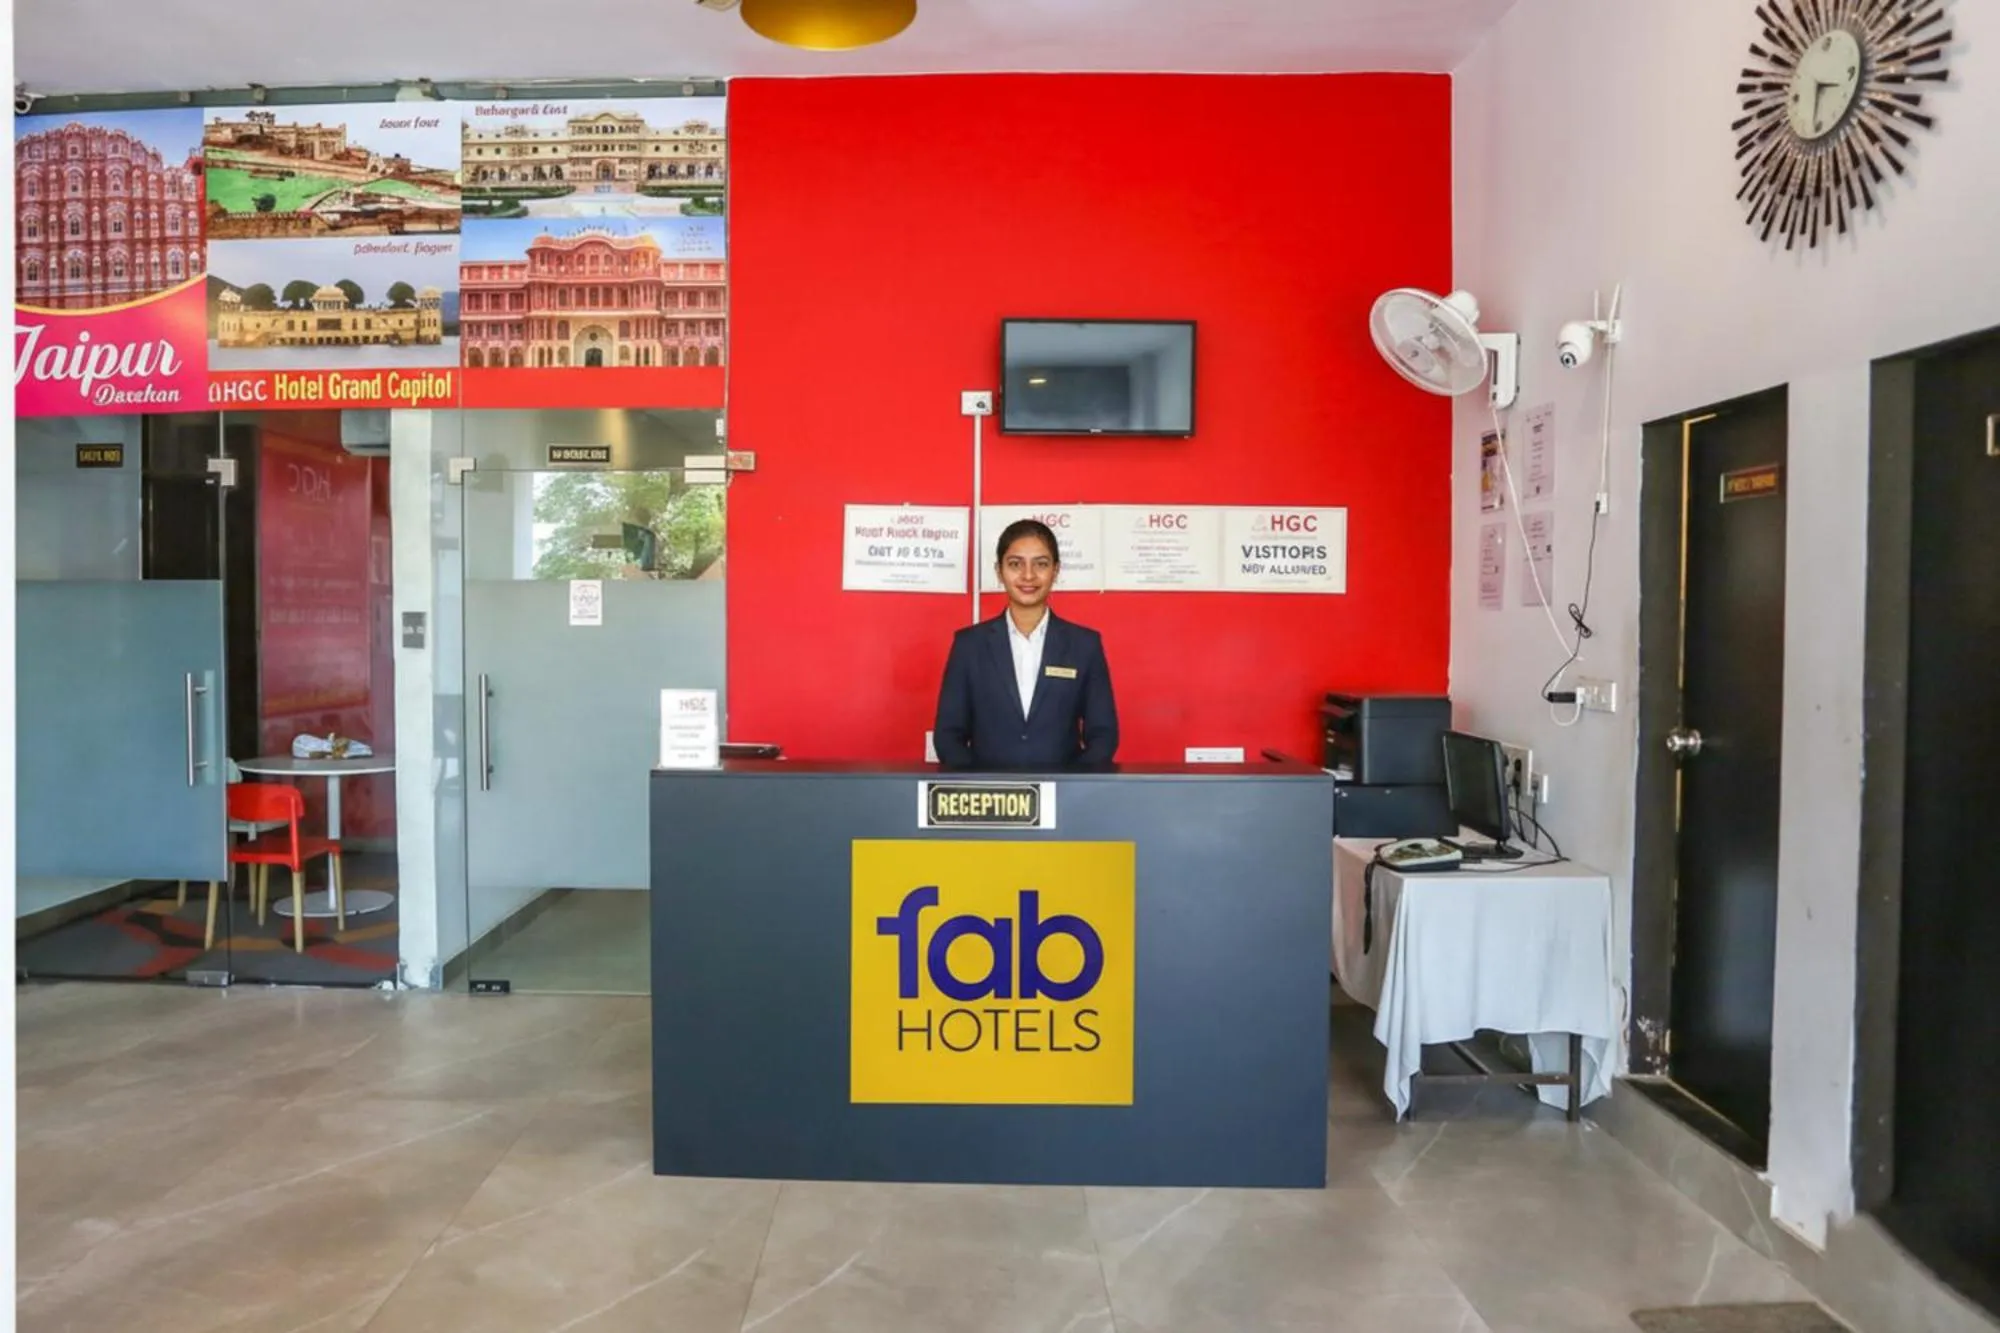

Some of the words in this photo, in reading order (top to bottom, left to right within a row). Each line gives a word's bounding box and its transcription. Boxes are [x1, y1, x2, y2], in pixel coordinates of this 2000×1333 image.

[15, 324, 182, 397] Jaipur
[274, 373, 323, 401] Hotel
[328, 372, 382, 400] Grand
[1149, 513, 1188, 529] HGC
[1271, 514, 1318, 532] HGC
[937, 793, 1030, 816] RECEPTION
[876, 885, 1105, 1002] fab
[898, 1008, 1101, 1053] HOTELS
